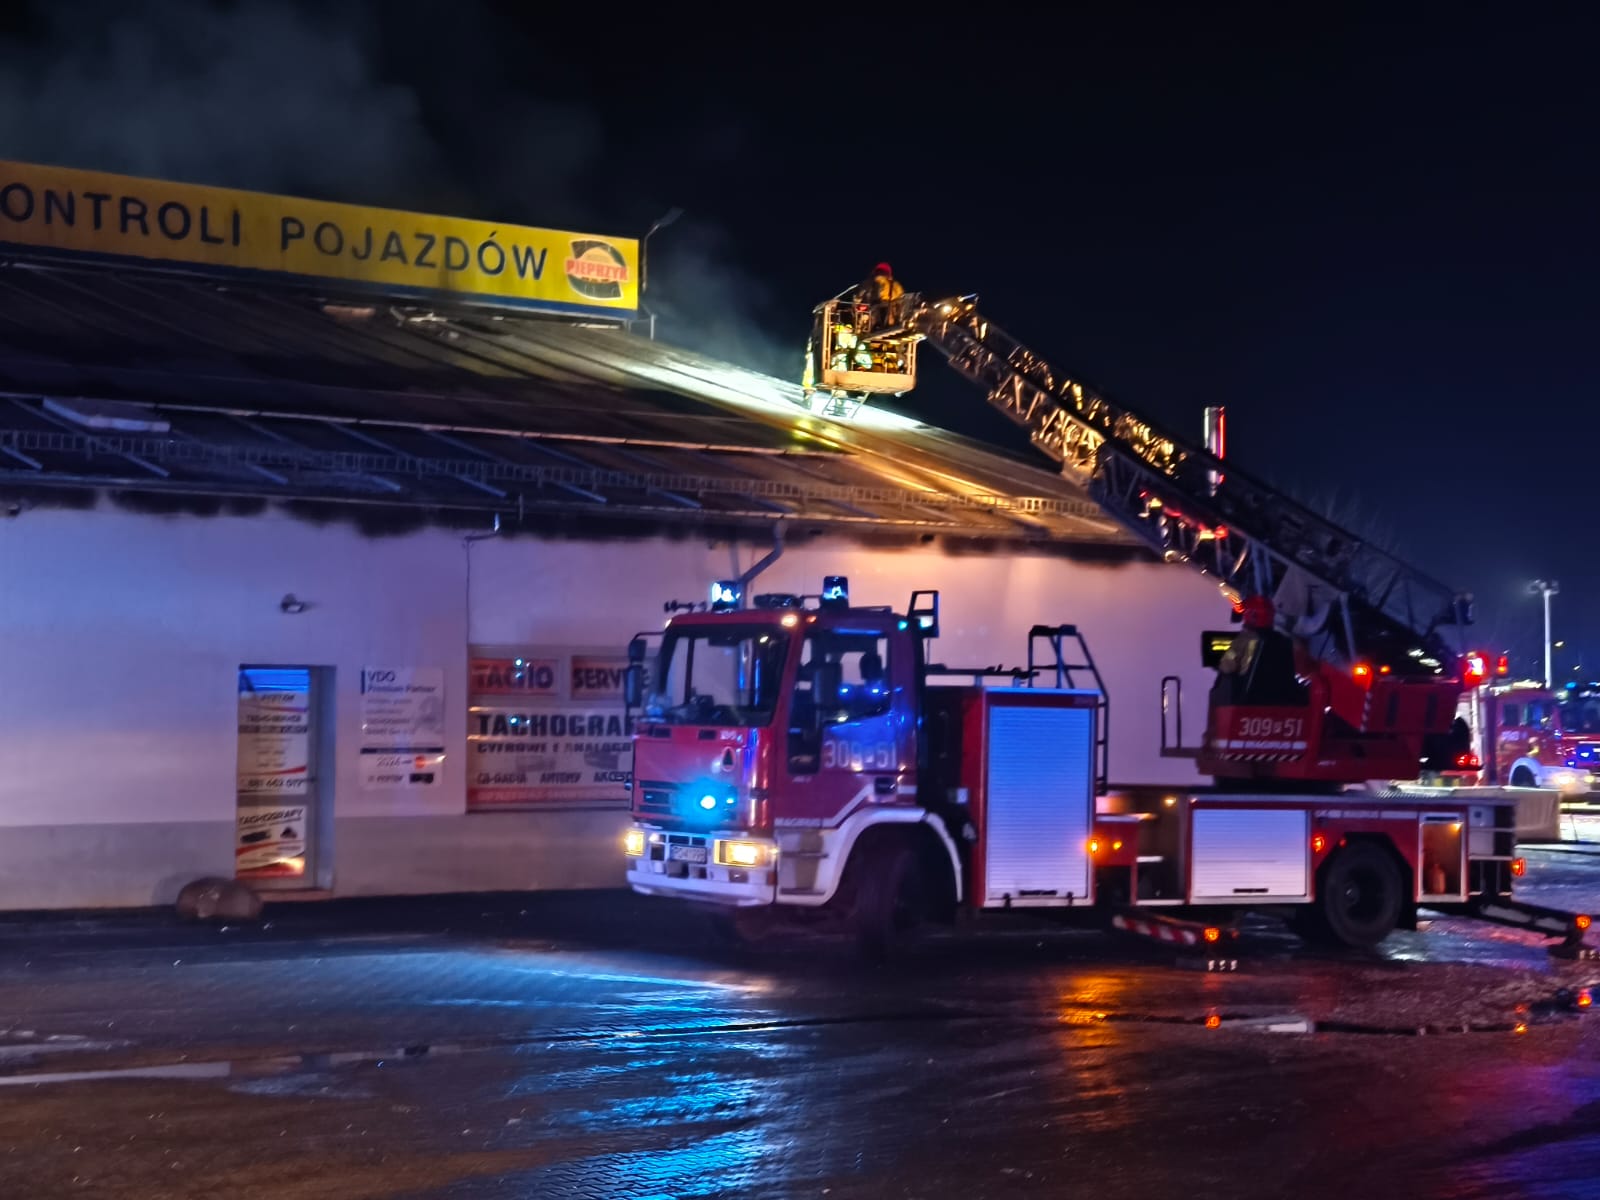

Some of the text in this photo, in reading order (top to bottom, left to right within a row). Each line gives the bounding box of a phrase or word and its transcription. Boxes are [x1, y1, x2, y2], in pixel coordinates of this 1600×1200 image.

[0, 183, 548, 280] ONTROLI POJAZDÓW
[367, 670, 396, 682] VDO
